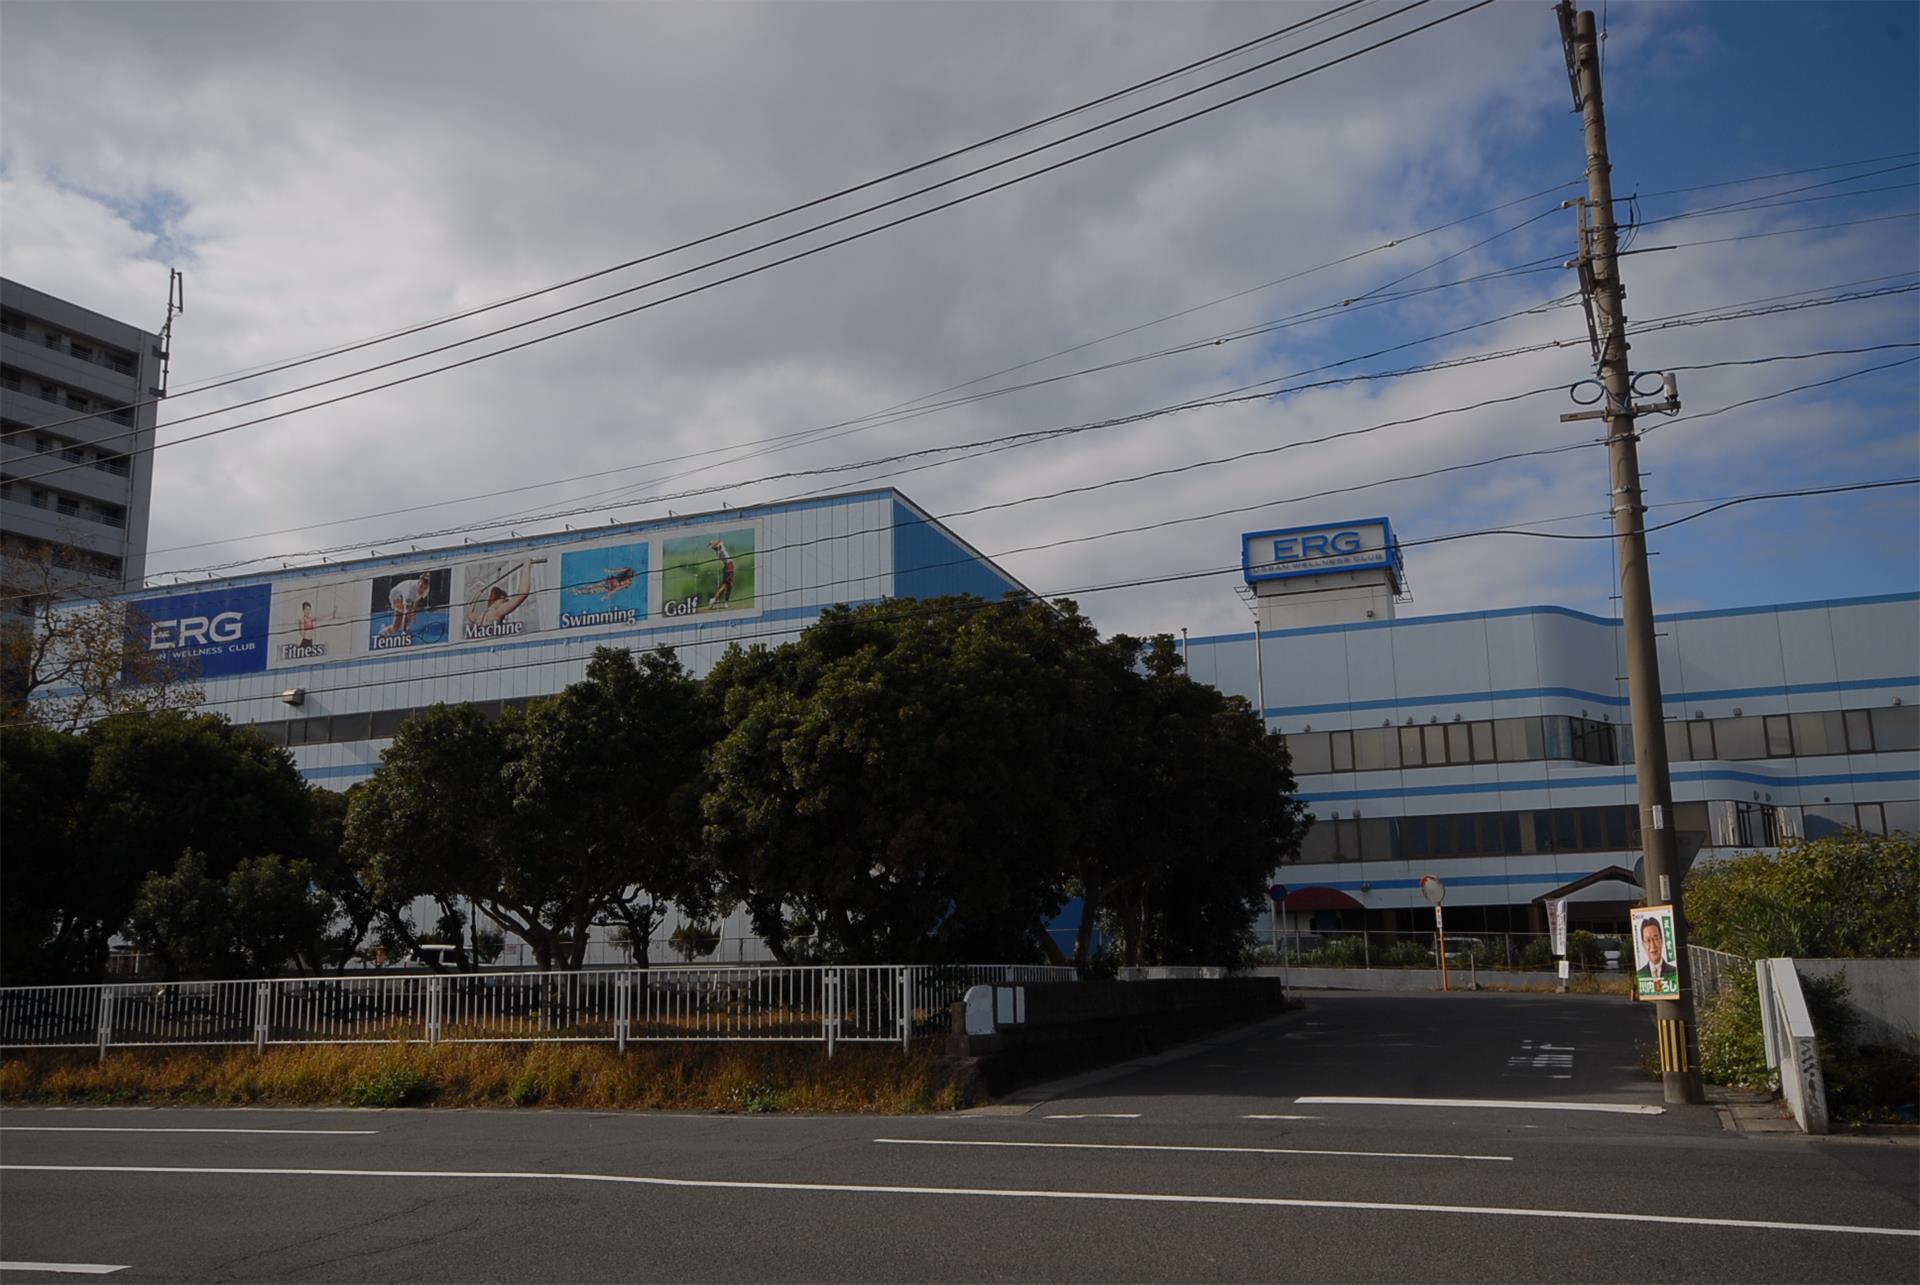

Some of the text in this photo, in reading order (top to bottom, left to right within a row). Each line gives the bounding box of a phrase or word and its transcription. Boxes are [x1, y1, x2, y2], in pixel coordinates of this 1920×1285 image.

[1273, 531, 1362, 562] ERG
[1353, 553, 1384, 562] CLUB
[664, 596, 698, 617] Golf
[561, 606, 637, 628] Swimming
[149, 611, 243, 651] ERG
[464, 620, 523, 639] Machine
[371, 631, 412, 650] Tennis
[172, 645, 223, 659] WELLNESS
[228, 642, 256, 653] CLUB
[281, 642, 324, 660] Fitness
[1639, 980, 1677, 993] 川内ろし
